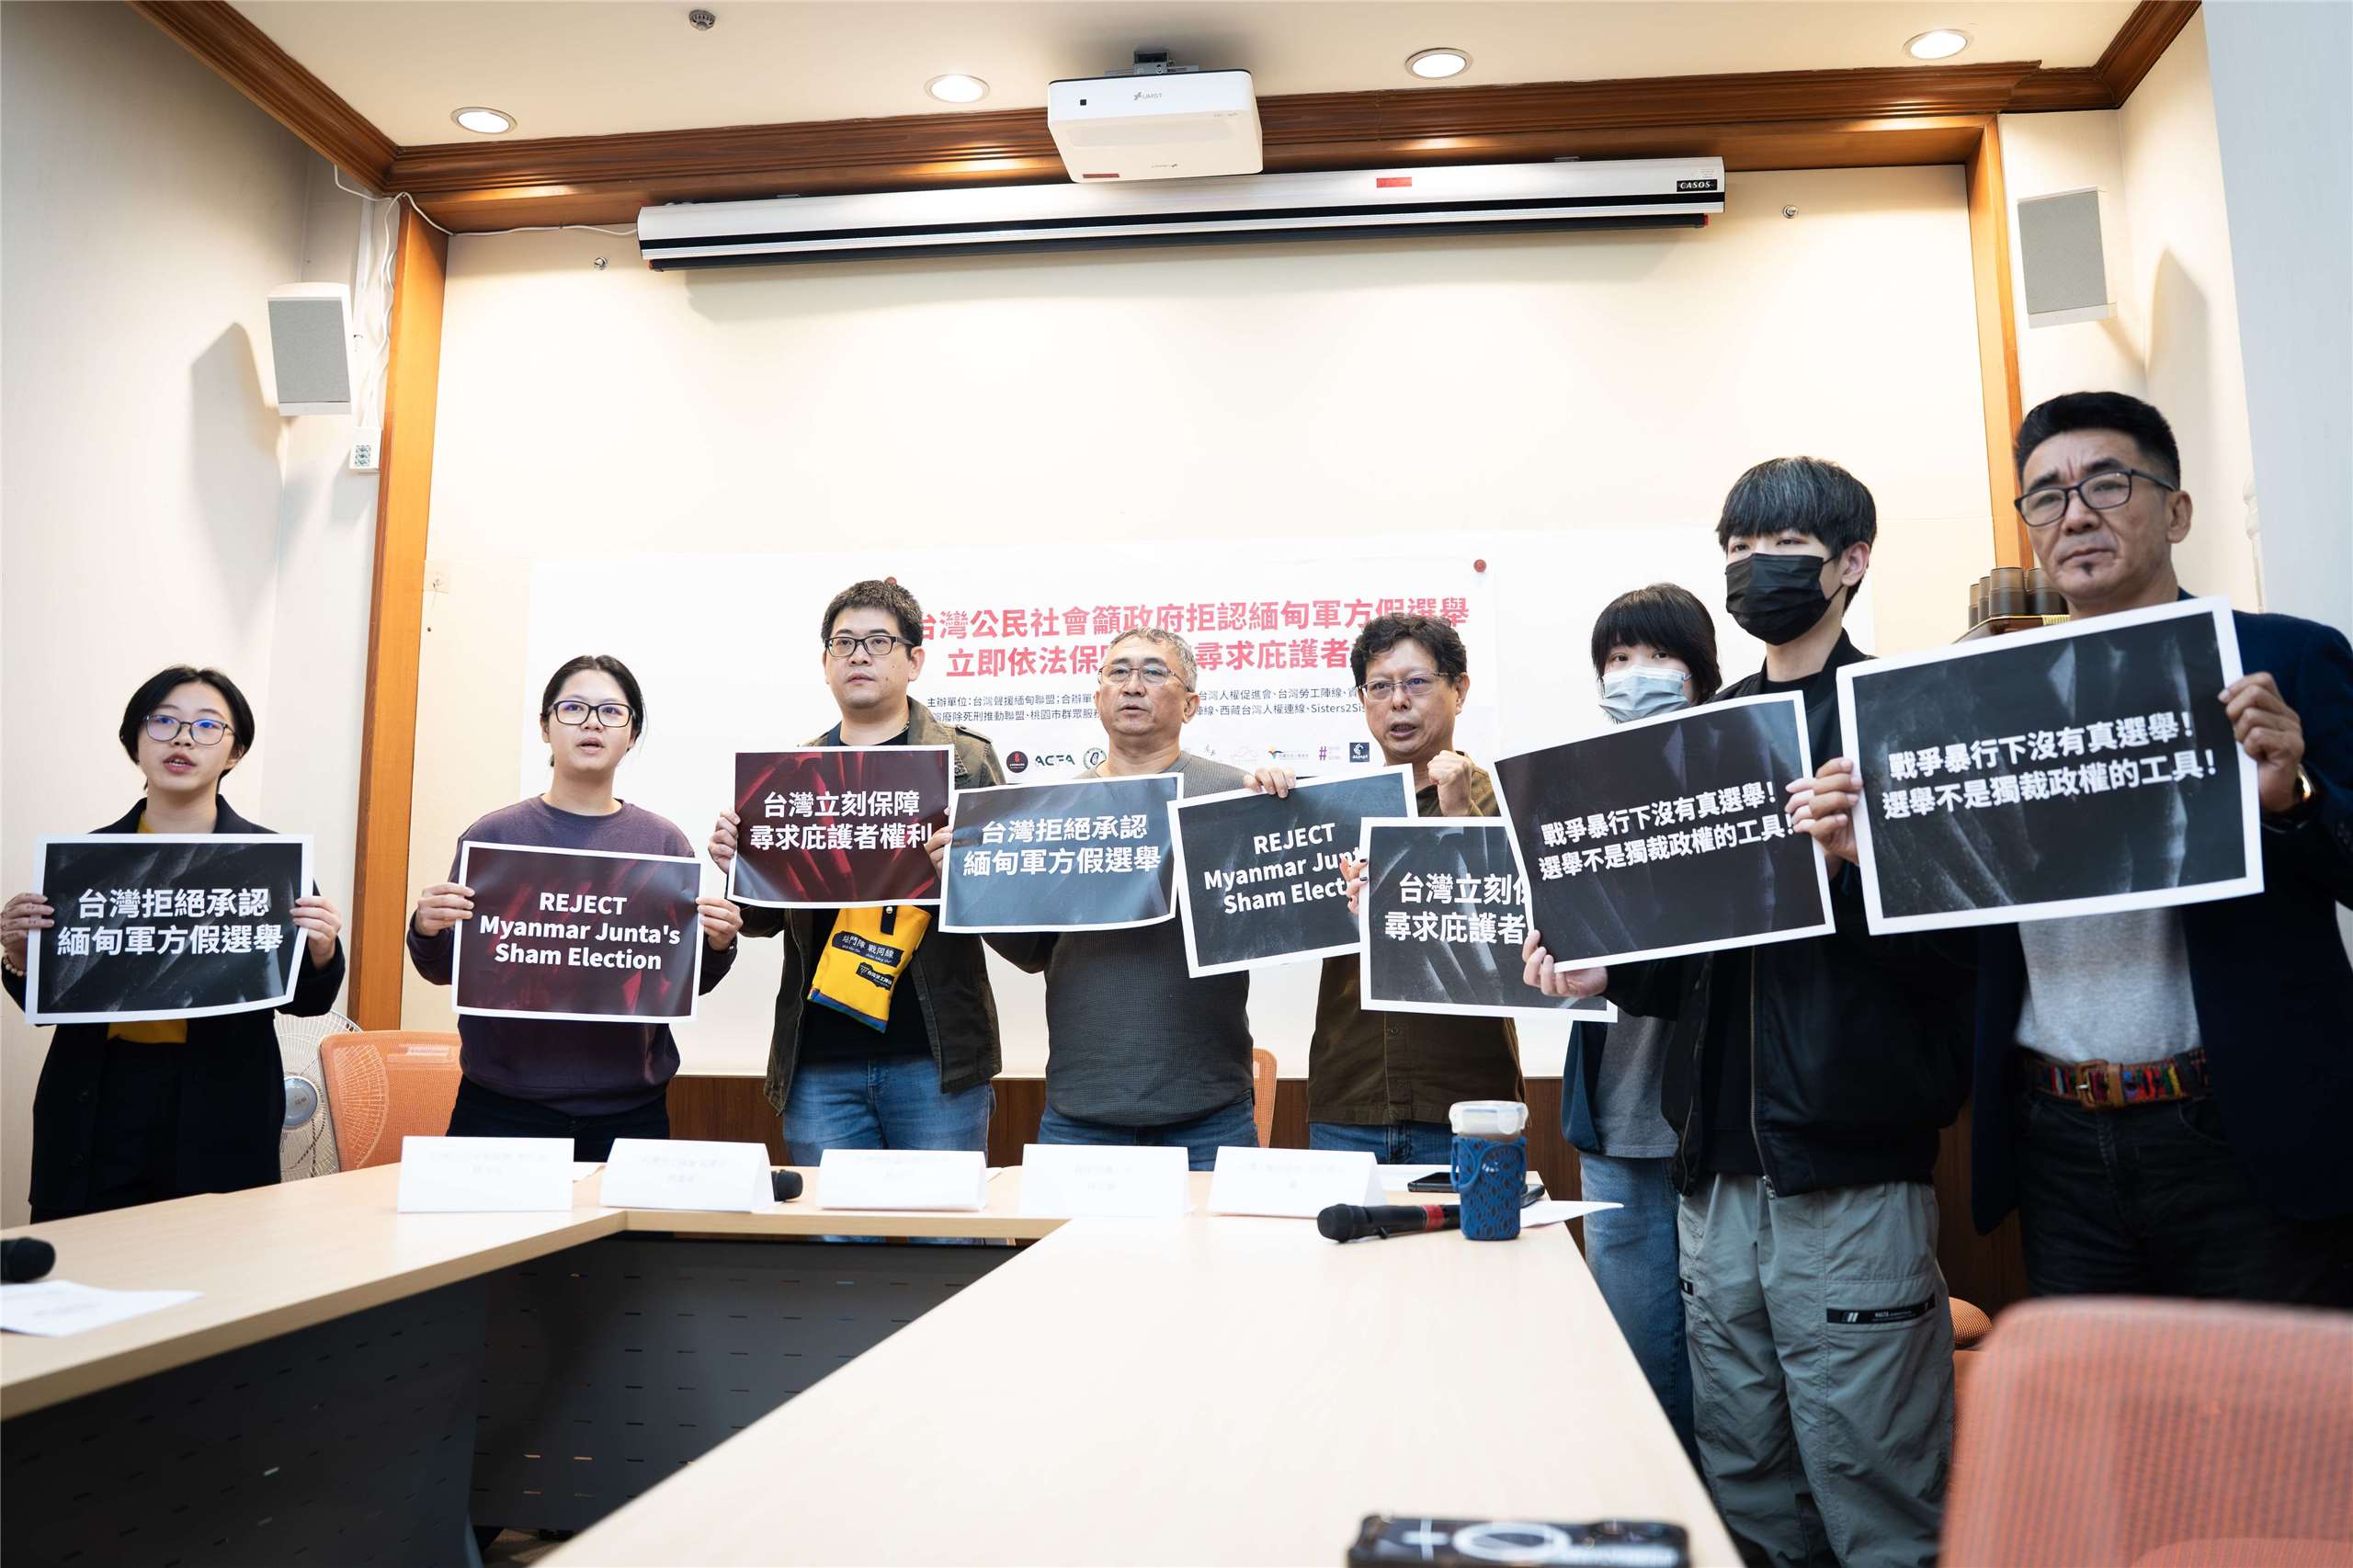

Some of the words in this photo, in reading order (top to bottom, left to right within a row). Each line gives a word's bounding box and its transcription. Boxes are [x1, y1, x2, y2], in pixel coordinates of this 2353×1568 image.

[1680, 181, 1711, 189] CASOS
[1888, 711, 2194, 782] 戰爭暴行下沒有真選舉！
[1881, 749, 2216, 821] 選舉不是獨裁政權的工具！
[764, 790, 920, 818] 台灣立刻保障
[1540, 781, 1777, 848] 戰爭暴行下沒有真選舉！
[749, 823, 932, 851] 尋求庇護者權利
[982, 813, 1148, 845] 台灣拒絕承認
[1253, 823, 1336, 855] REJECT
[962, 845, 1162, 877] 緬甸軍方假選舉
[1538, 813, 1794, 881] 選舉不是獨裁政權的工具！
[1204, 858, 1307, 892] Myanmar
[78, 888, 269, 919] 台灣拒絕承認
[539, 892, 628, 915] REJECT
[1223, 890, 1287, 915] Sham
[57, 924, 284, 956] 緬甸軍方假選舉
[479, 916, 591, 943] Myanmar
[595, 923, 681, 945] Junta's
[1385, 911, 1527, 944] 尋求庇護者
[494, 943, 562, 966] Sham
[568, 947, 662, 970] Election
